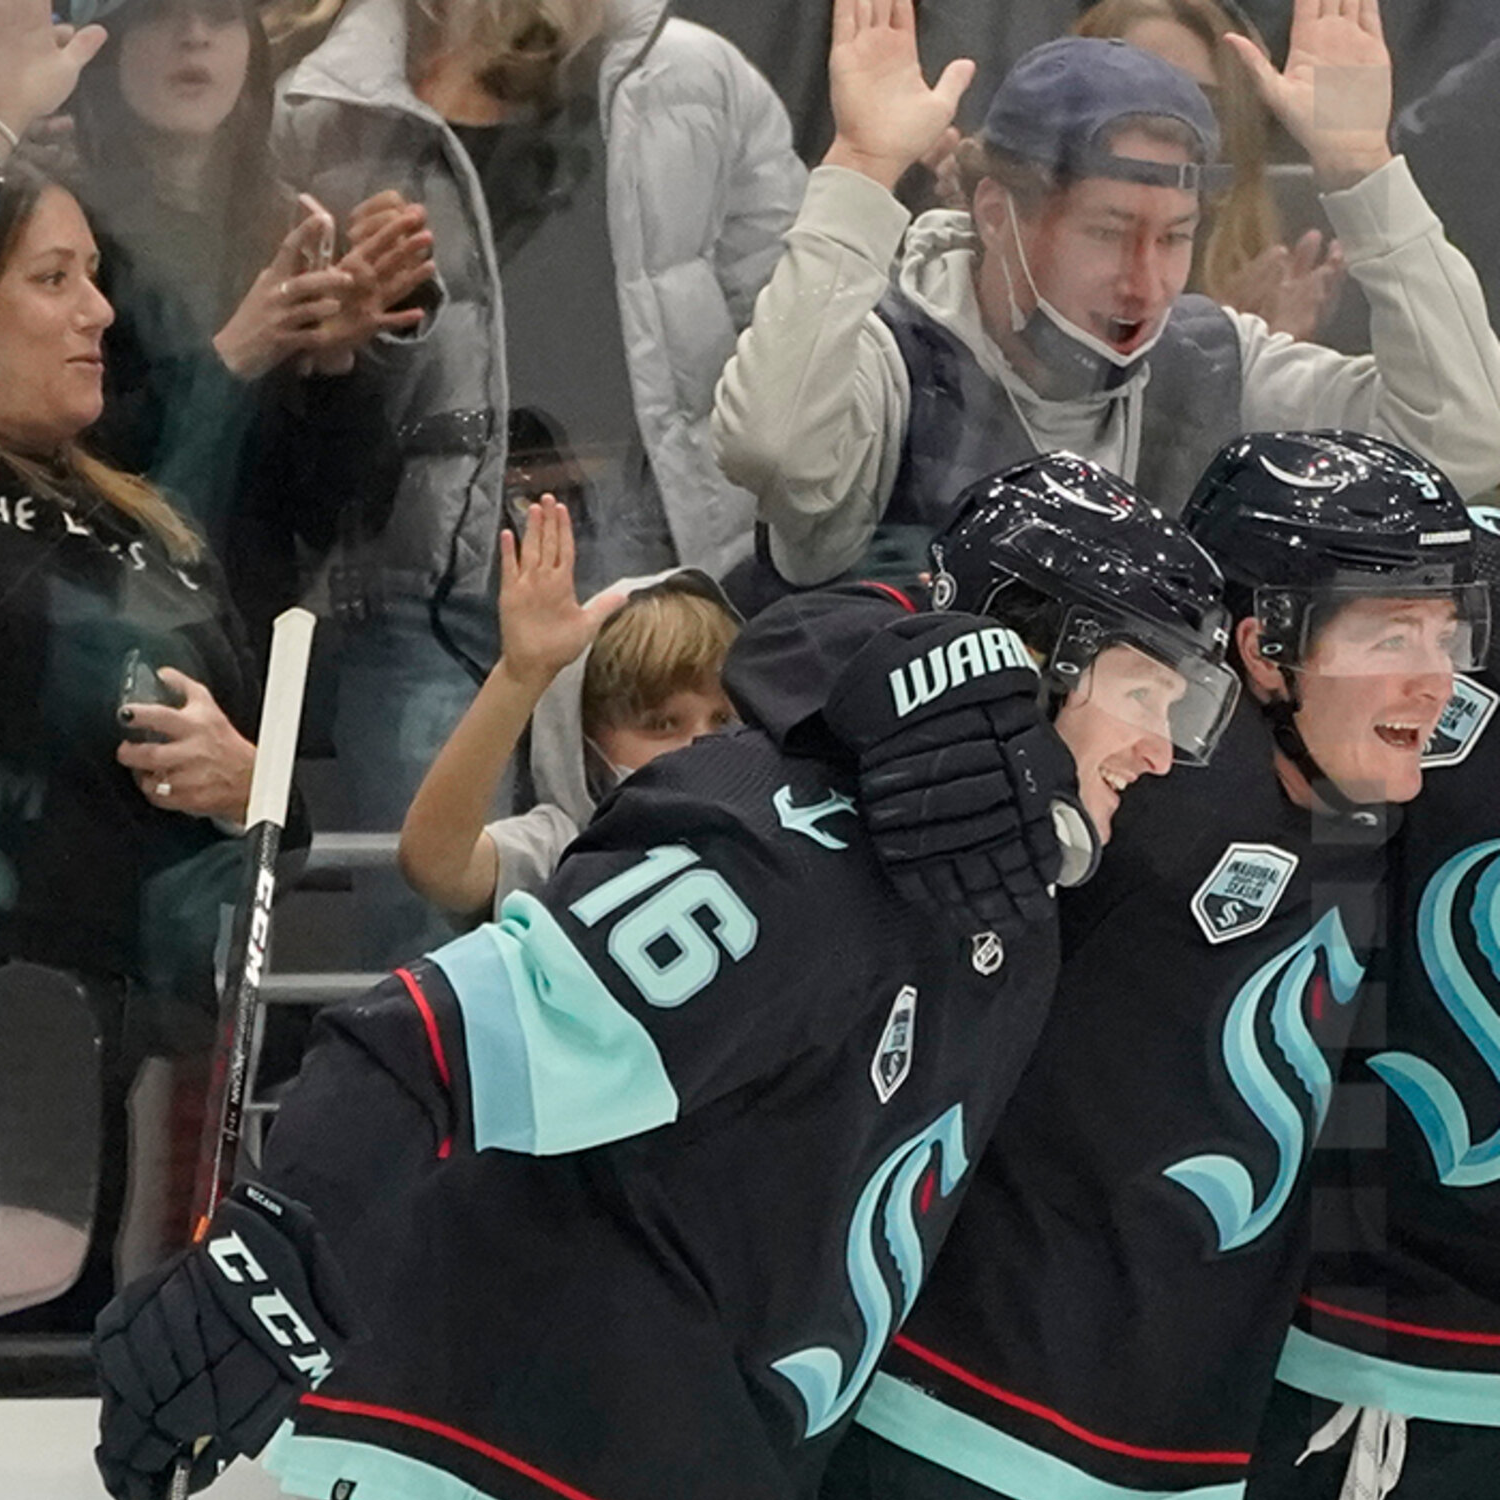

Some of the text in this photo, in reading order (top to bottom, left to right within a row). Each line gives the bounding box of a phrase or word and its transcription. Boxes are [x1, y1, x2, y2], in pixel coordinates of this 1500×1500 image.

[245, 865, 276, 988] CCM
[567, 844, 760, 1008] 16
[207, 1229, 335, 1392] CCM
